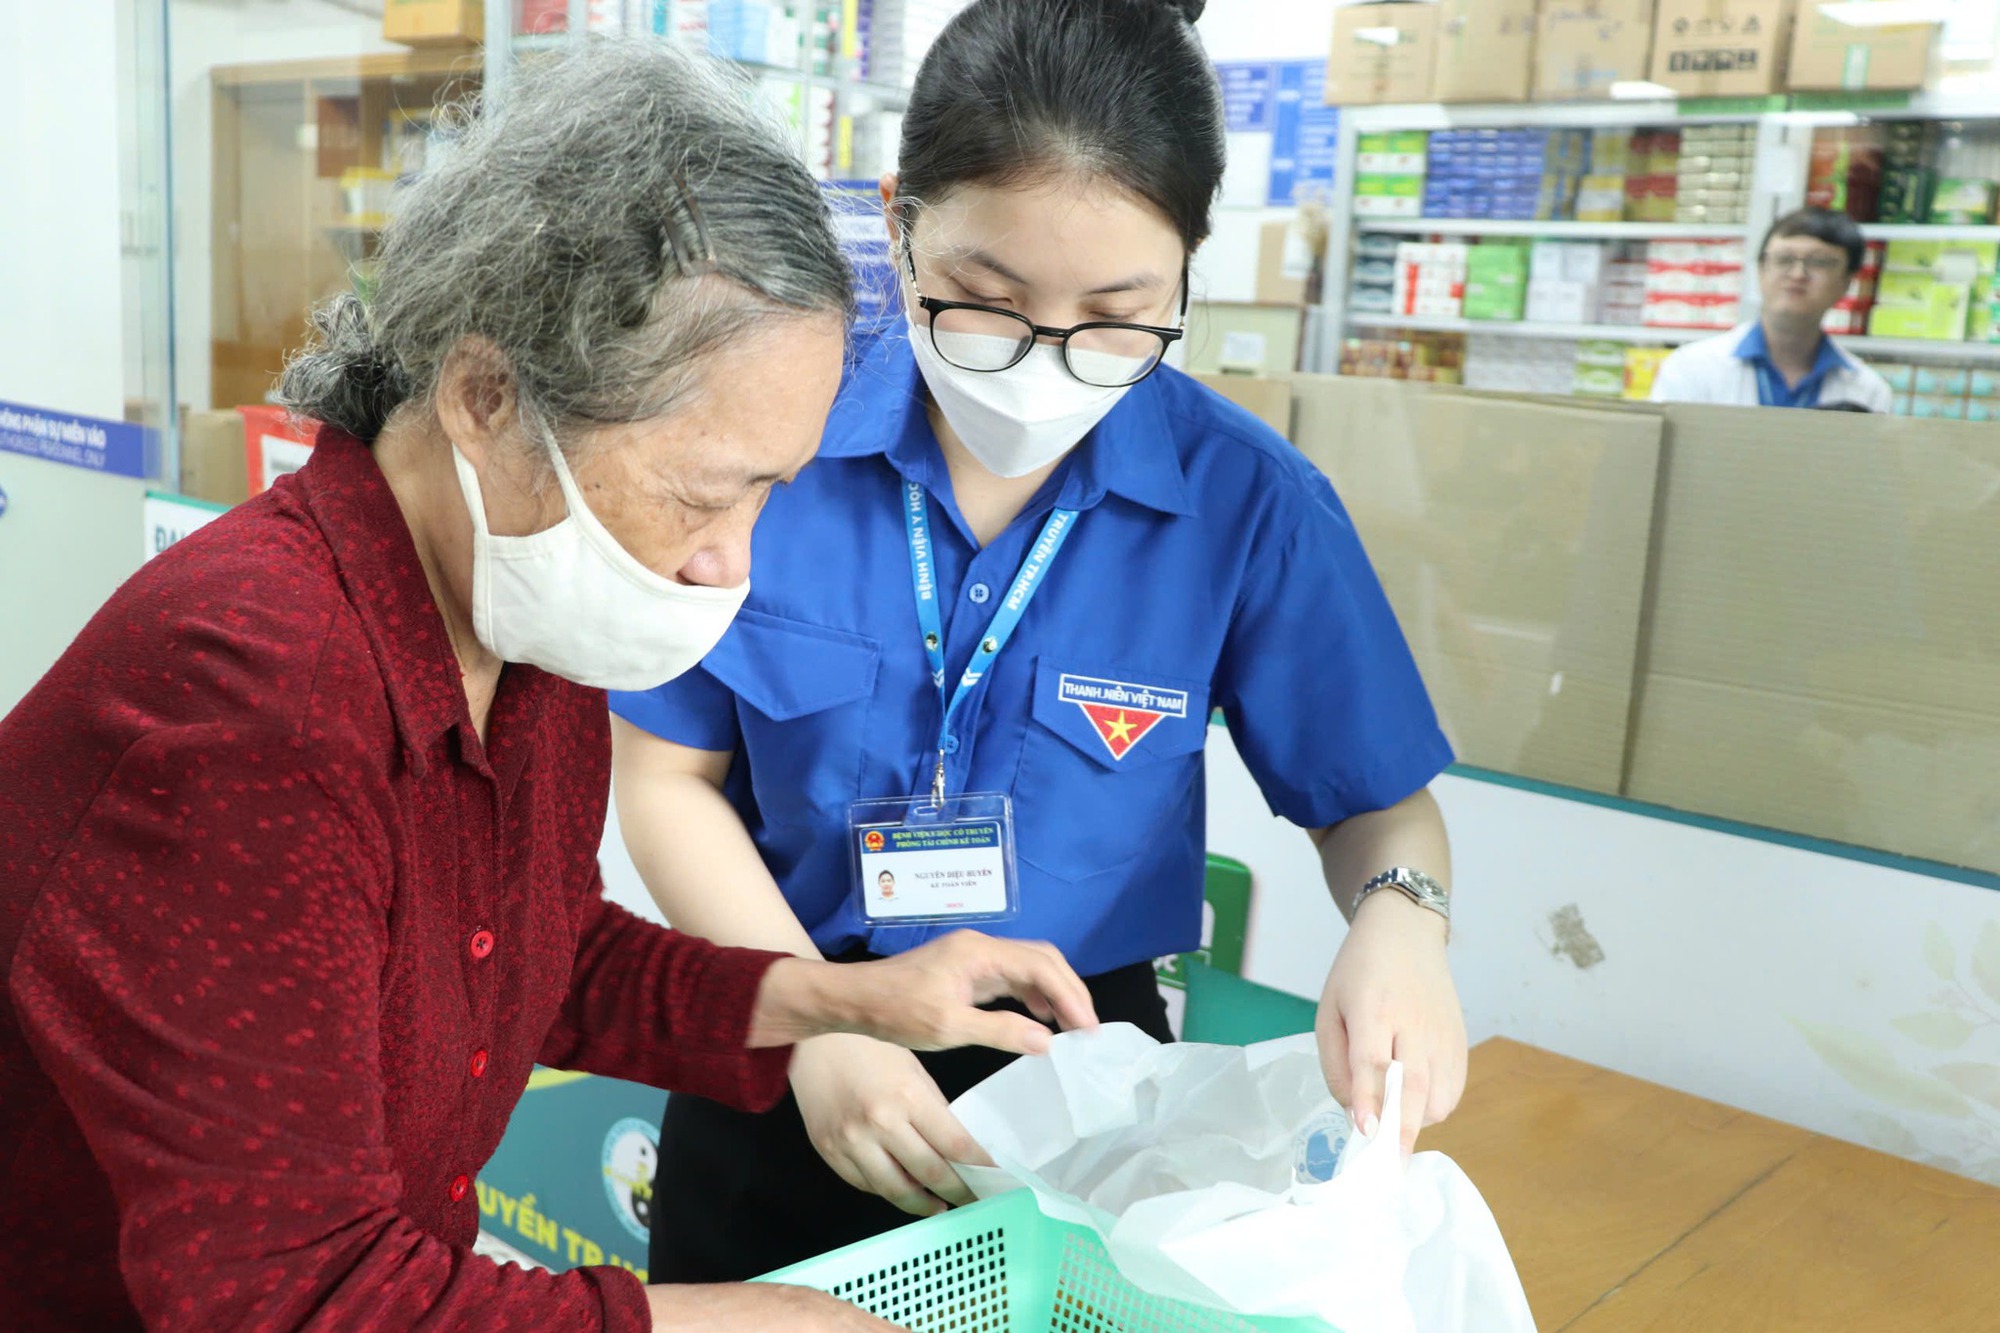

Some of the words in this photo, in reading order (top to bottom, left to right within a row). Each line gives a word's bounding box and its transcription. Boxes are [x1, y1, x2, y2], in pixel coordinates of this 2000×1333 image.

[908, 482, 922, 512] HỌC
[912, 516, 923, 525] Y
[912, 526, 928, 560] VIỆN
[917, 562, 933, 600] BỆNH
[1064, 682, 1102, 699] THANH
[1103, 685, 1130, 703] NIÊN
[1130, 688, 1156, 708] VIỆT
[1156, 696, 1183, 710] NAM
